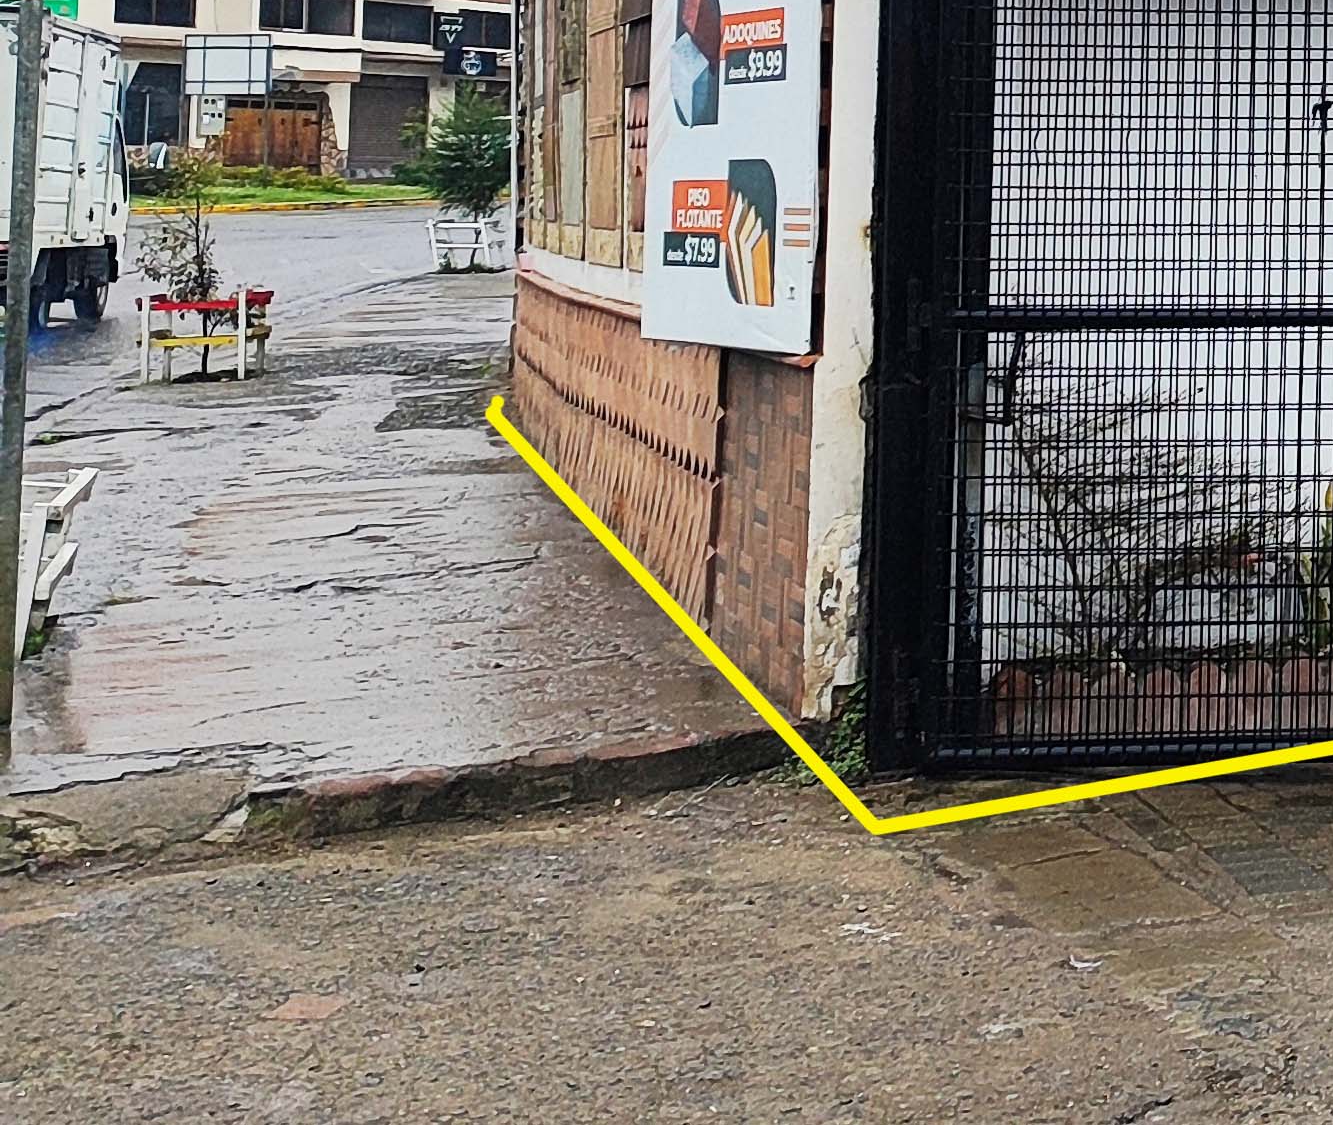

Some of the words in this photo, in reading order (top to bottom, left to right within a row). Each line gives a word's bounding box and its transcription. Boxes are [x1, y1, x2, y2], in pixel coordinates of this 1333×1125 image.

[723, 19, 781, 45] ADOQUINES
[748, 49, 782, 81] $9.99
[688, 188, 710, 206] PISO
[676, 209, 723, 228] FLOTANTE
[685, 234, 715, 265] $7.99
